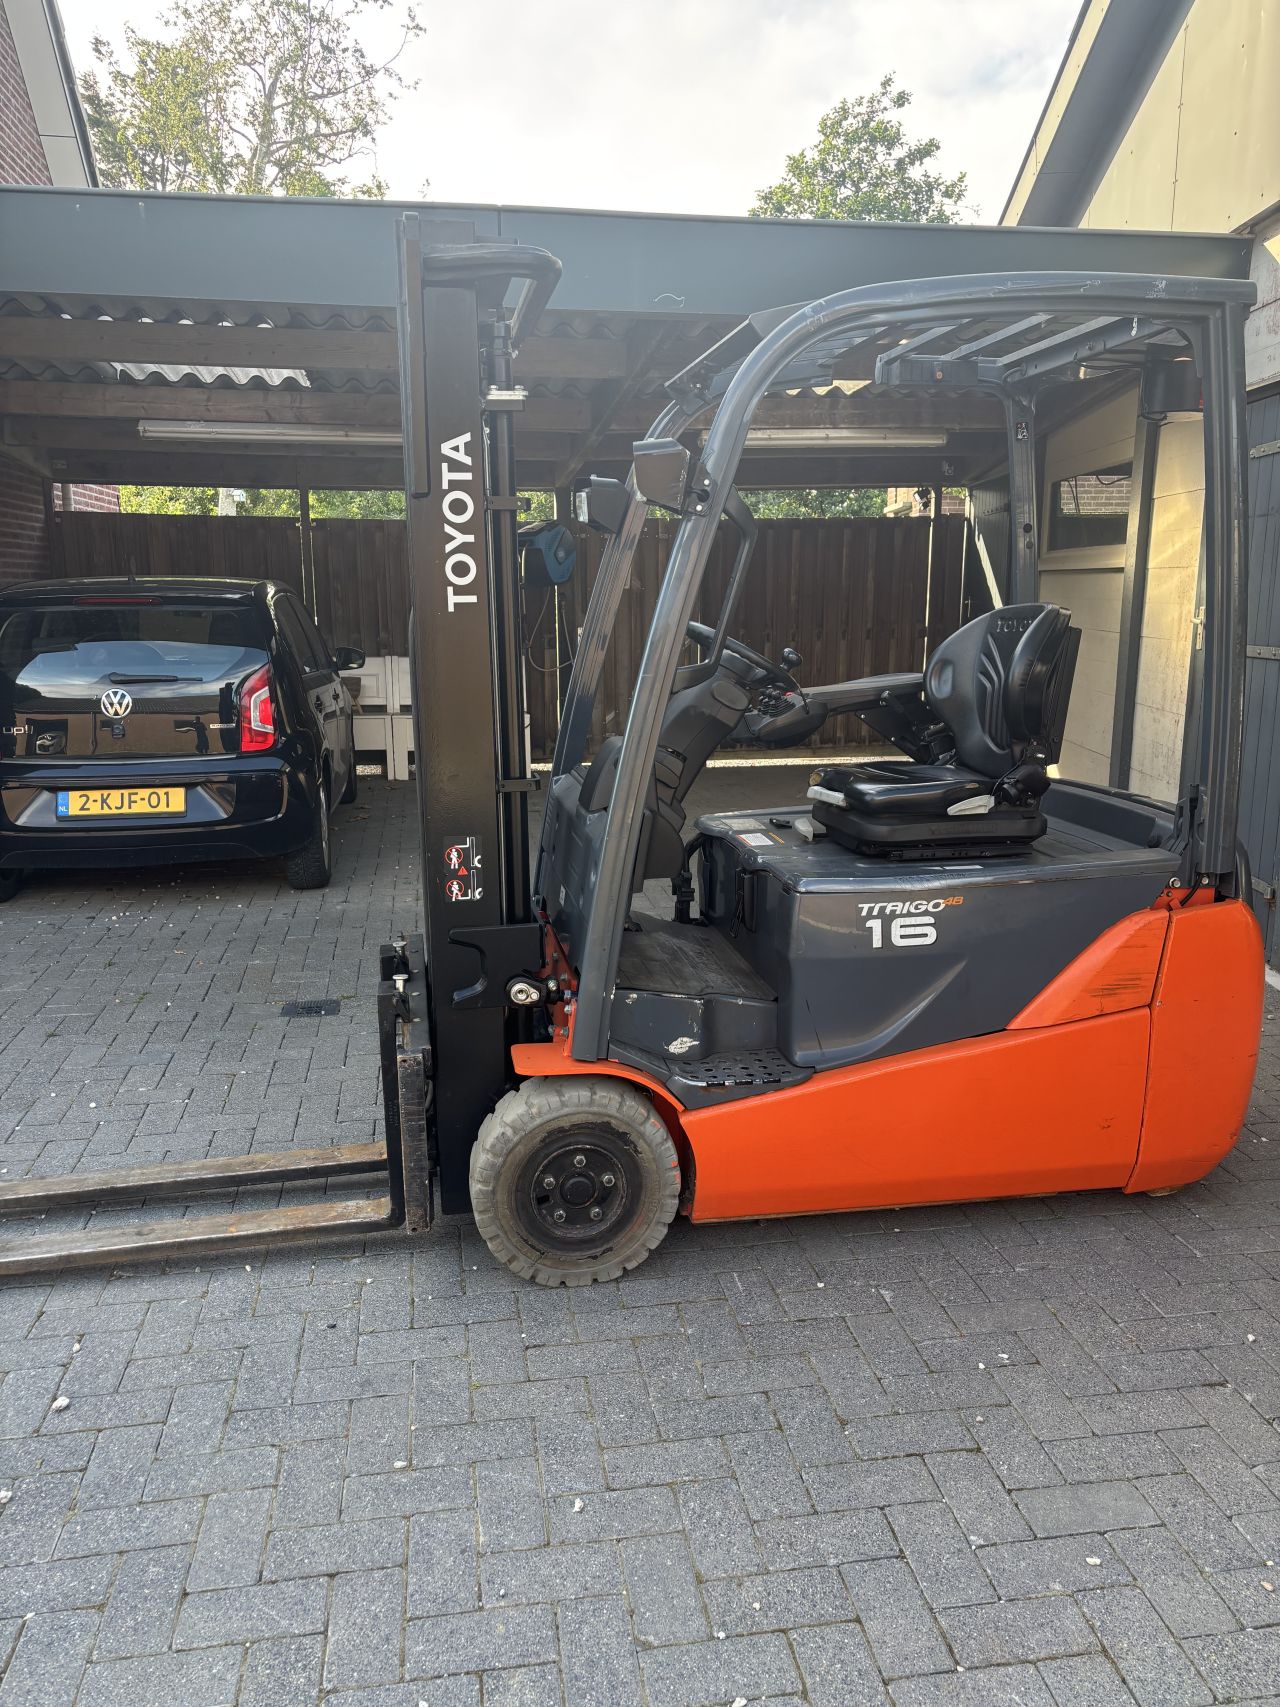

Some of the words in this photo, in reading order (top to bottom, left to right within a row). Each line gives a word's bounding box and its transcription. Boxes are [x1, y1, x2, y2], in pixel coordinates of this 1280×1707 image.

[441, 431, 478, 612] TOYOTA
[101, 689, 132, 718] VW
[78, 791, 170, 812] 2-KJF-01
[858, 899, 946, 917] TRAIGO
[865, 916, 938, 949] 16
